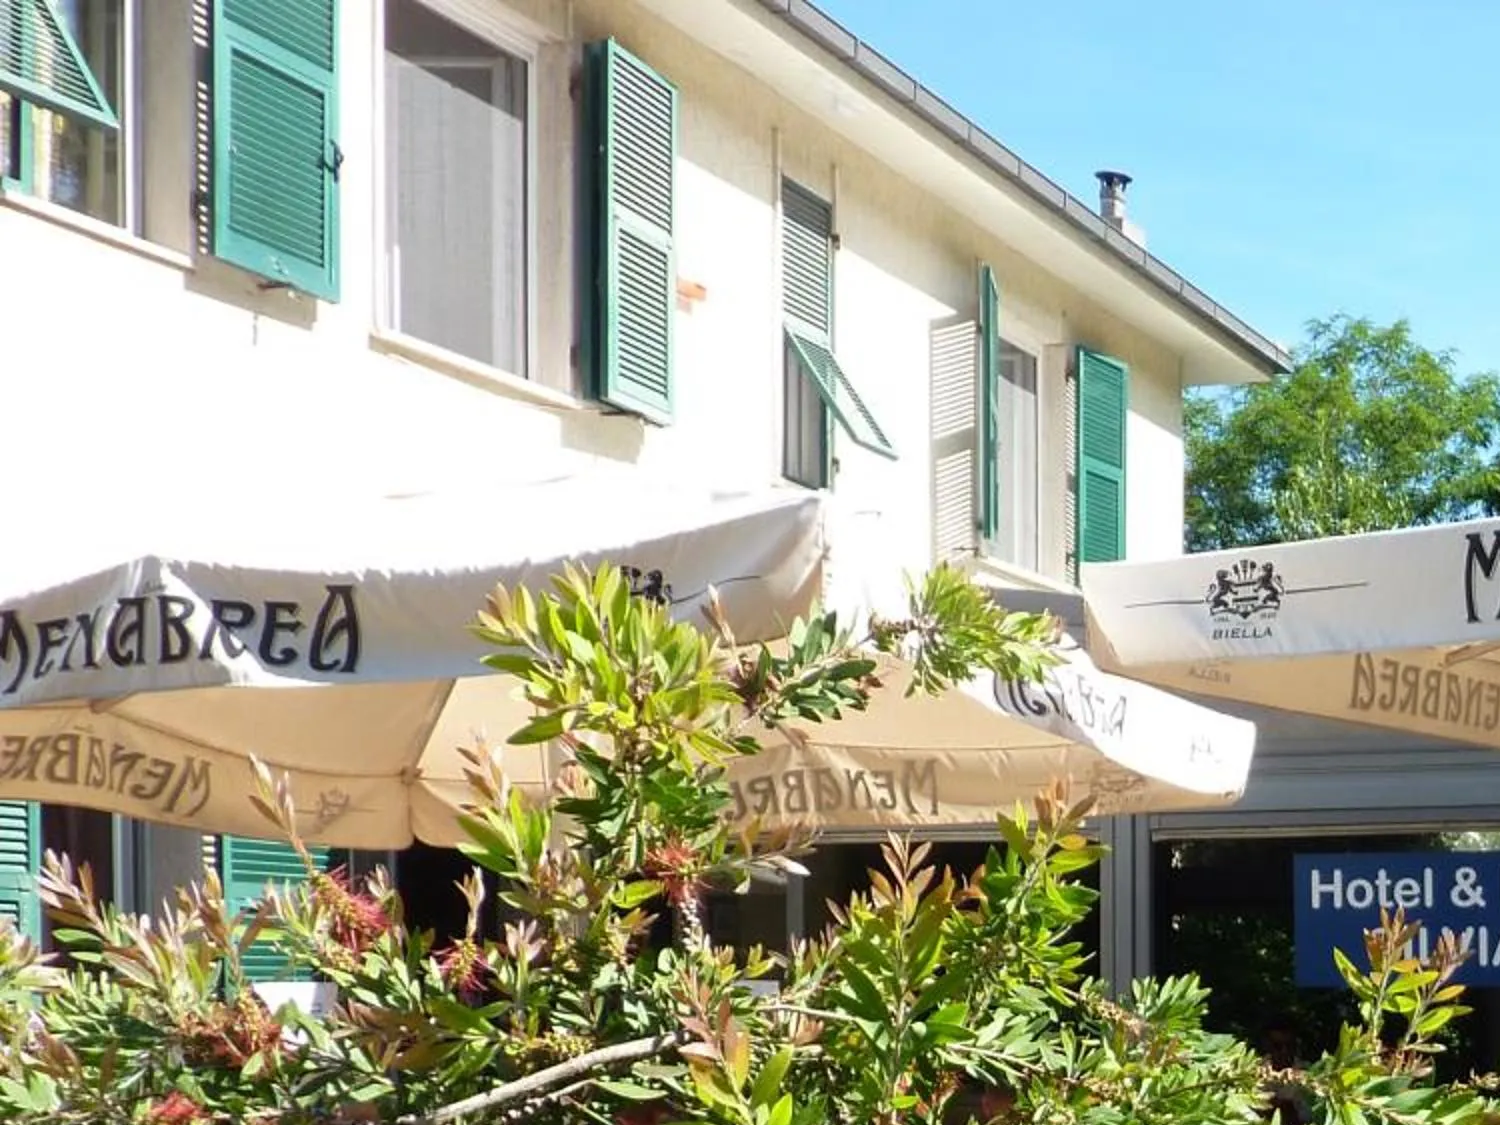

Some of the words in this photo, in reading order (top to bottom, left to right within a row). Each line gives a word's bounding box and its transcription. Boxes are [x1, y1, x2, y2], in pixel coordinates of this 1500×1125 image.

[1212, 626, 1273, 640] BIELLA
[1310, 867, 1434, 909] Hotel
[1450, 867, 1487, 908] &
